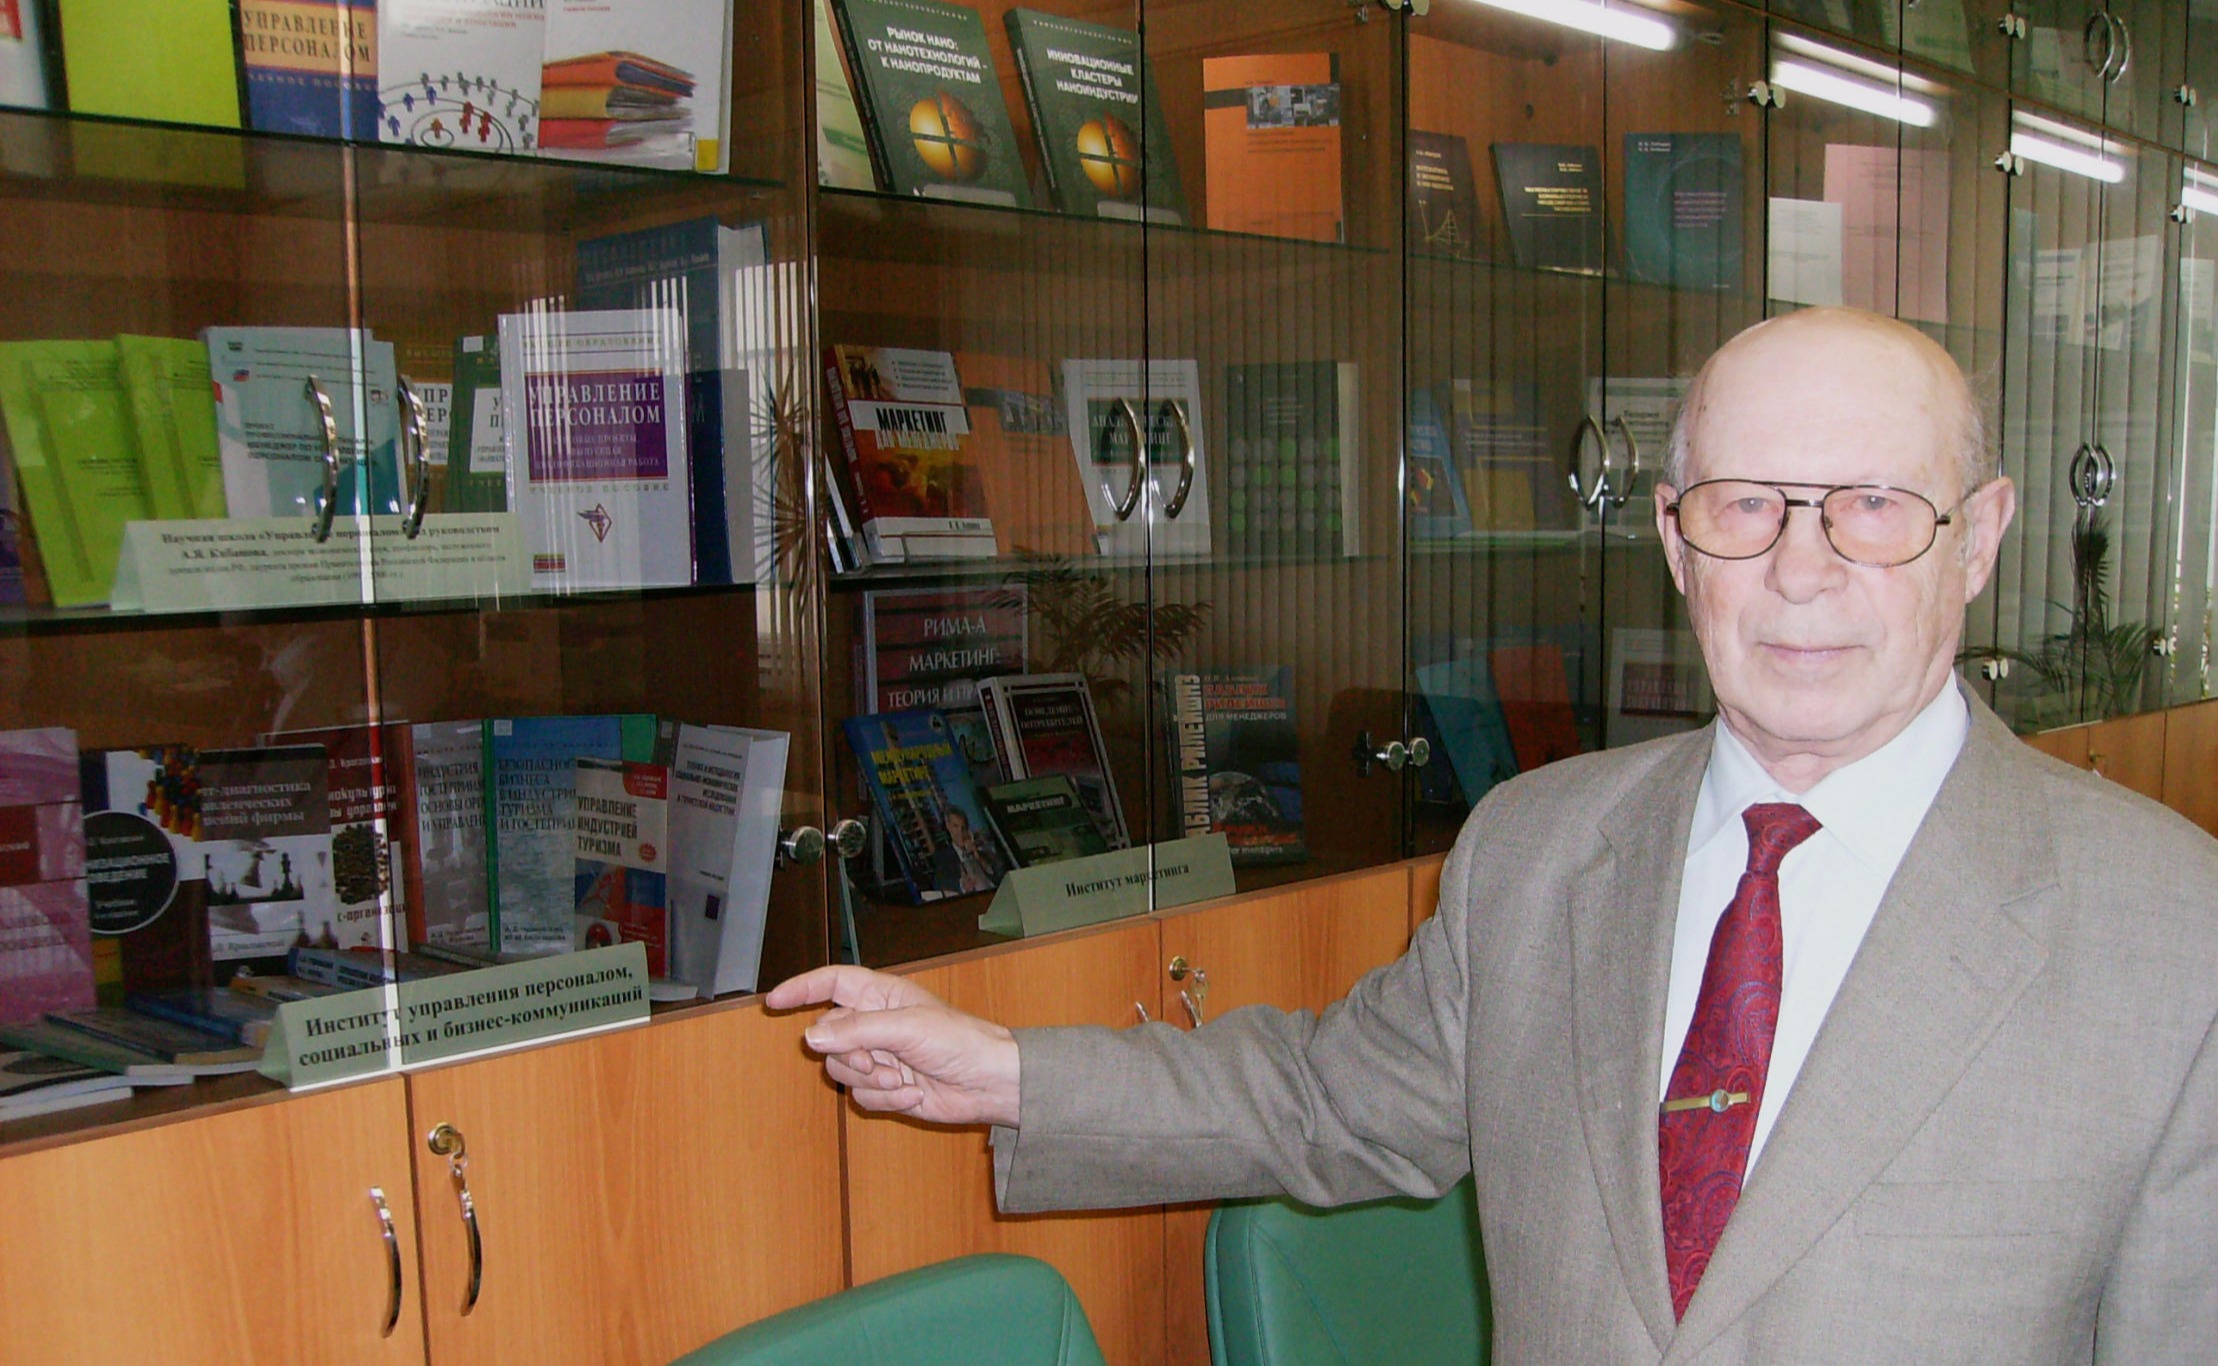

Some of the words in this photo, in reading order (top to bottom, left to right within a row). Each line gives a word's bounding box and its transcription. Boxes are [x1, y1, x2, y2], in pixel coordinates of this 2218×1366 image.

[886, 26, 927, 43] РЫНОК
[926, 33, 959, 50] НАНО:
[867, 39, 882, 51] ОТ
[883, 41, 981, 69] НАНОТЕХНОЛОГИЙ
[1046, 48, 1135, 76] ИННОВАЦИОННЫЕ
[880, 56, 890, 68] К
[890, 57, 981, 84] НАНОПРОДУКТАМ
[1070, 67, 1123, 87] КЛАСТЕРЫ
[1056, 79, 1139, 104] НАНОИНДУСТРИИ
[529, 382, 660, 405] УПРАВЛЕНИЕ
[530, 405, 660, 427] ПЕРСОНАЛОМ
[875, 407, 947, 434] МАРКЕТИНГ
[924, 615, 987, 637] РИМА-А
[887, 687, 941, 708] ТЕОРИЯ
[578, 796, 637, 819] УПРАВЛЕНИЕ
[577, 816, 638, 840] ИНДУСТРИЕЙ
[577, 835, 622, 857] ТУРИЗМА
[1066, 876, 1122, 898] Институт
[1124, 863, 1190, 887] мартинга
[305, 1008, 400, 1037] Институт
[408, 987, 520, 1024] управления
[525, 966, 633, 998] персоналом,
[299, 1031, 421, 1067] социальных
[427, 1028, 438, 1042] и
[443, 985, 643, 1038] бизнес-коммуникаций
